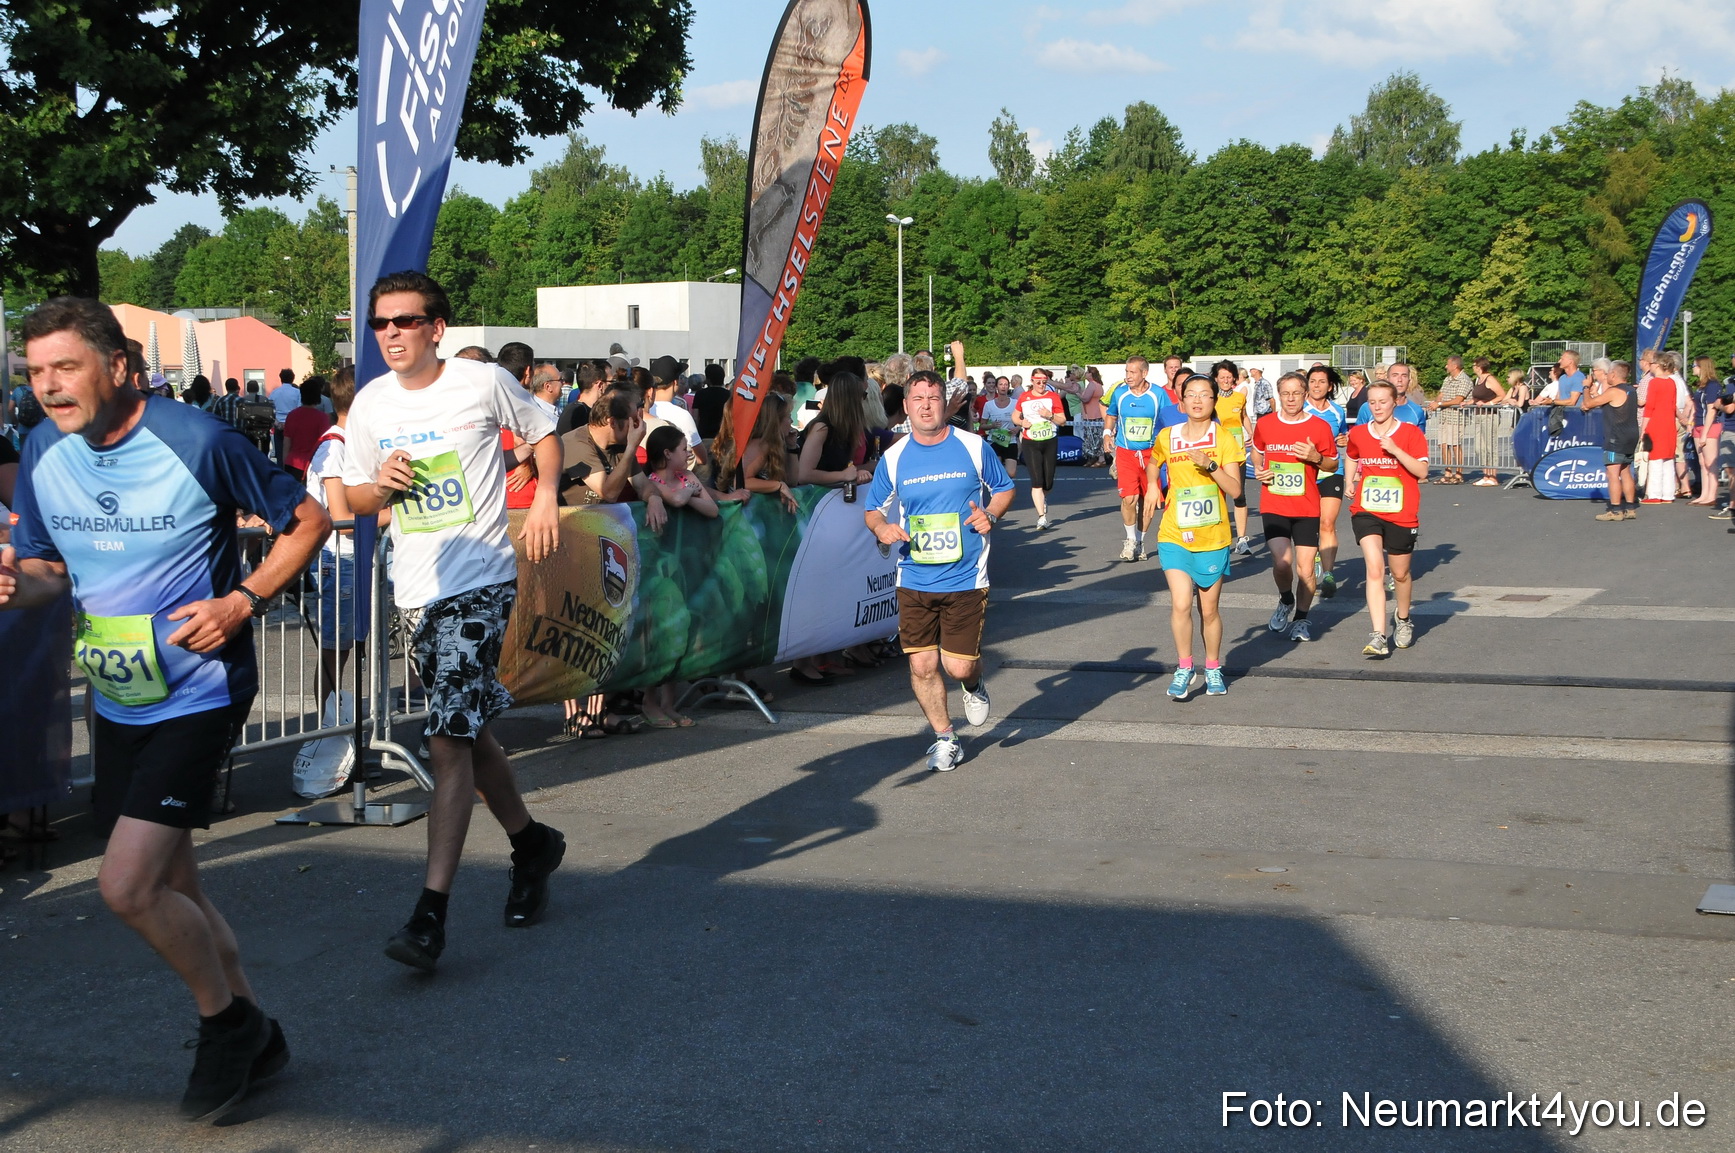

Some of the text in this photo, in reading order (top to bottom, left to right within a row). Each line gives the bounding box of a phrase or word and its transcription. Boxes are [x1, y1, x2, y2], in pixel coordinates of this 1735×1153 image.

[429, 0, 465, 143] AUTO
[1032, 429, 1051, 438] 5107
[1129, 426, 1147, 435] 477
[1169, 454, 1190, 463] MAX
[903, 471, 967, 486] energiegeladen
[399, 478, 463, 514] 1189
[1363, 488, 1399, 503] 1341
[1182, 499, 1213, 517] 790
[93, 540, 125, 551] TEAM
[911, 531, 958, 552] 1259
[78, 645, 154, 683] 1231
